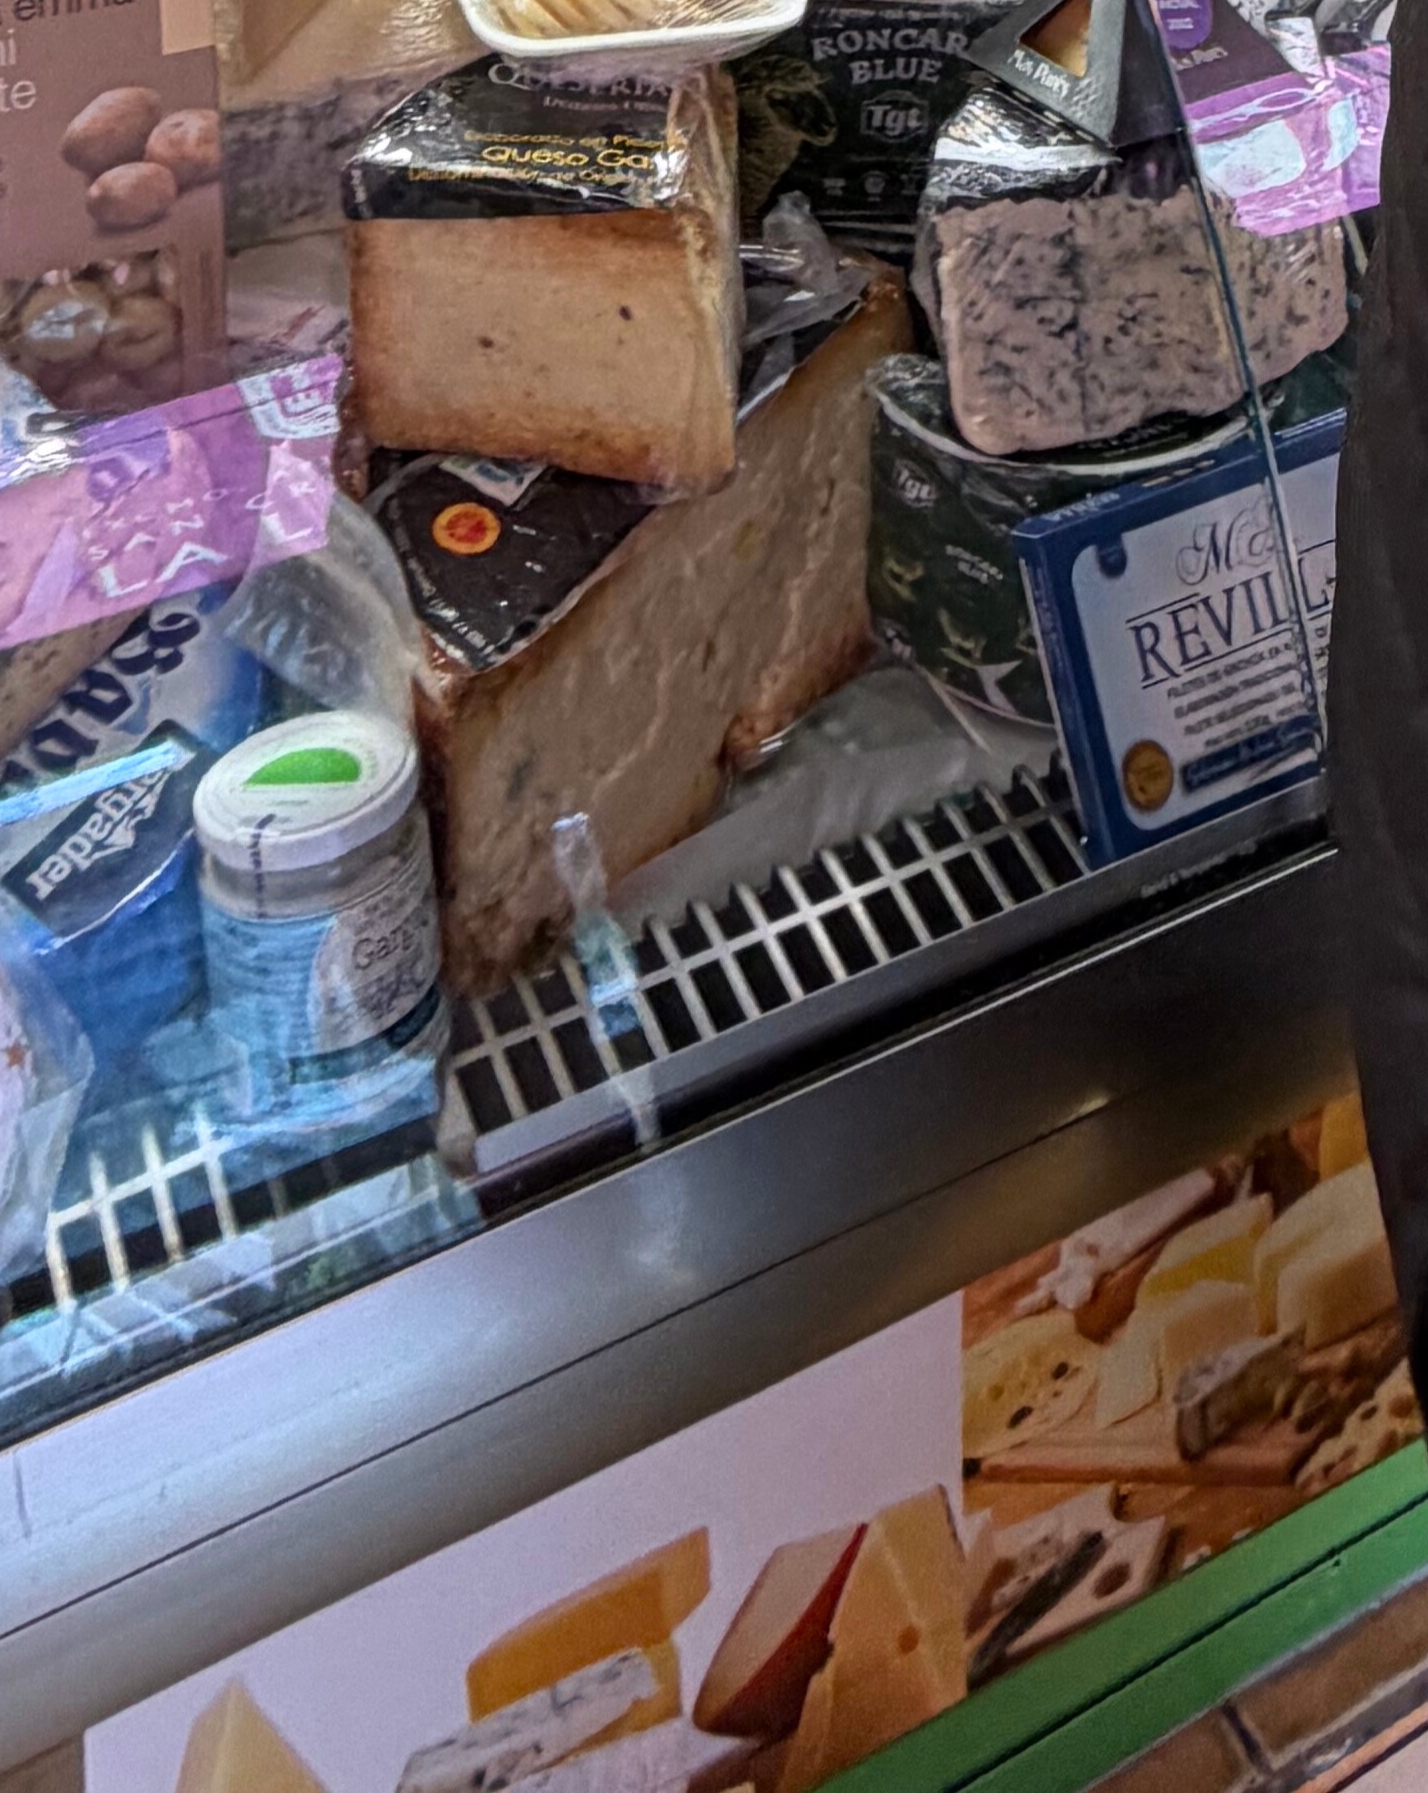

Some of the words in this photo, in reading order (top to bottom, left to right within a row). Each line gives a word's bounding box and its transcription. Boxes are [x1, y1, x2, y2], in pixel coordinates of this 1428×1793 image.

[810, 26, 972, 63] RONCAR
[848, 56, 943, 85] BLUE
[481, 145, 591, 167] Queso
[97, 540, 230, 600] LA
[1128, 557, 1337, 684] REVILL
